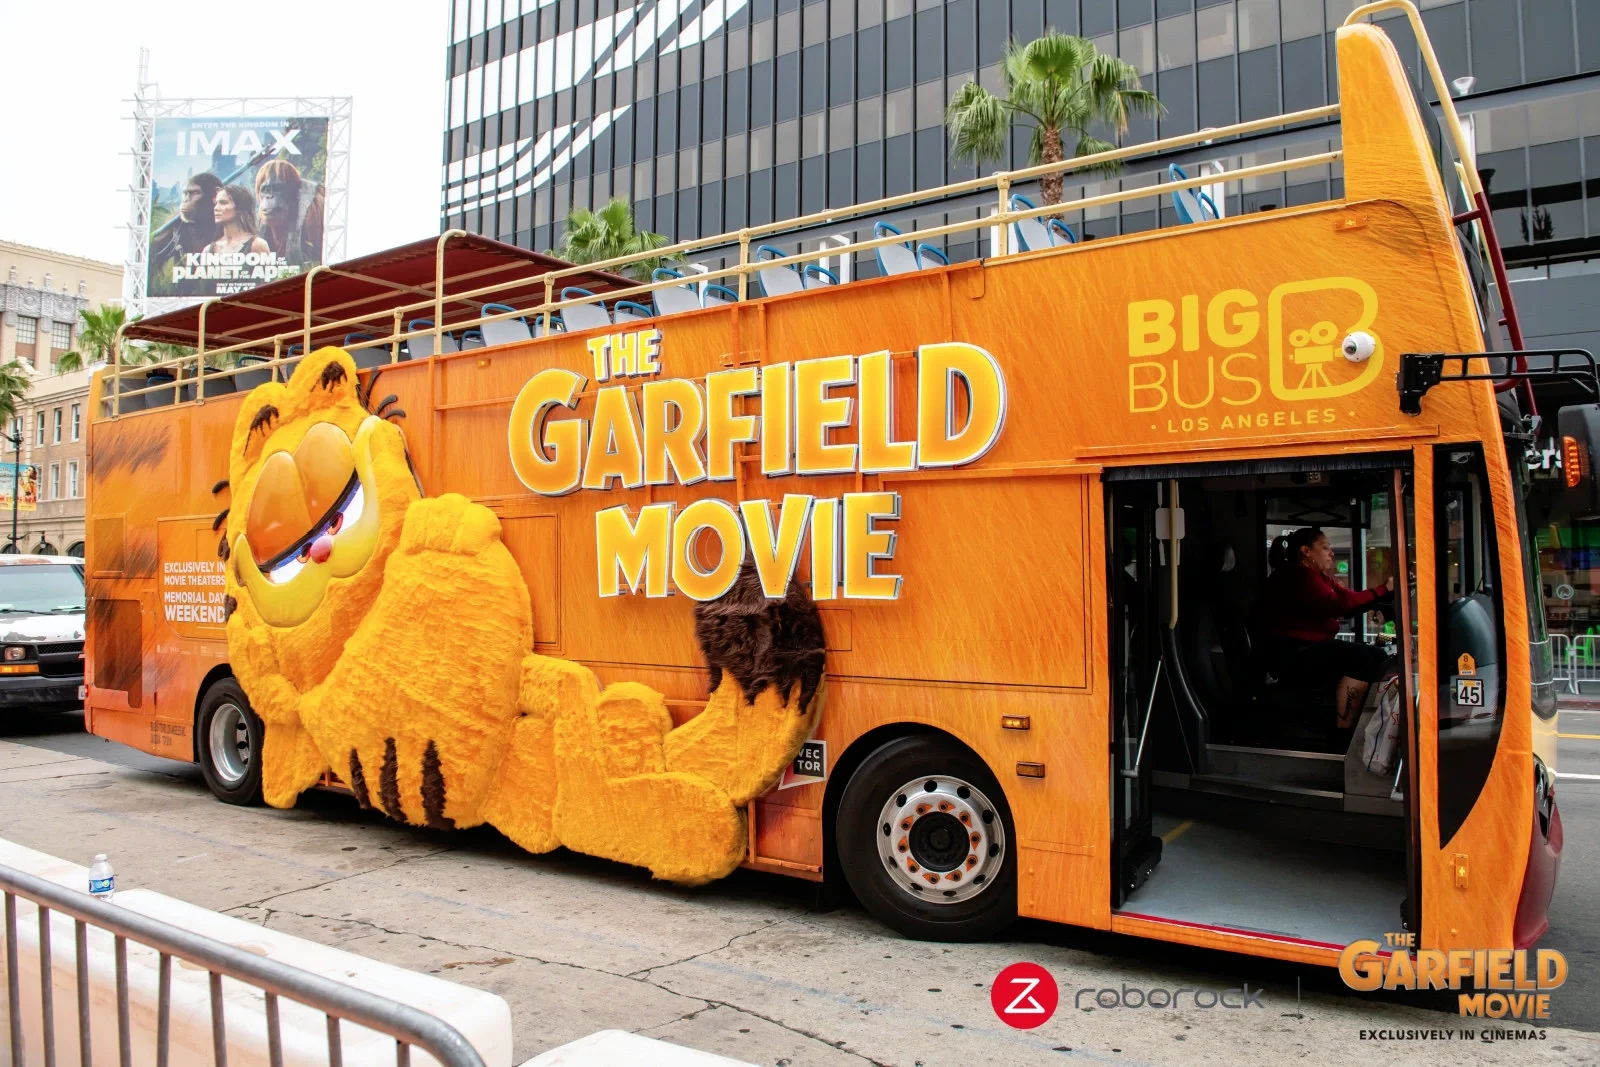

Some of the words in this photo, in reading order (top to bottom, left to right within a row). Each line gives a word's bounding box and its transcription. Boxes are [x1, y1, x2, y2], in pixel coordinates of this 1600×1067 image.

[176, 129, 302, 156] IMAX
[186, 252, 276, 266] KINGDOM
[172, 266, 242, 284] PLANET
[216, 286, 241, 294] MAY
[1127, 288, 1261, 357] BIG
[586, 328, 662, 382] THE
[1128, 352, 1262, 413] BUS
[507, 341, 1008, 497] GARFIELD
[1167, 417, 1209, 433] LOS
[1220, 408, 1336, 430] ANGELES
[595, 491, 903, 602] MOVIE
[164, 561, 215, 573] EXCLUSIVELY
[217, 562, 226, 572] IN
[164, 575, 186, 586] MOVIE
[188, 575, 226, 586] THEATERS
[164, 592, 207, 604] MEMORIAL
[208, 592, 225, 604] DAY
[164, 604, 226, 623] WEEKEND
[1459, 686, 1480, 704] 45
[798, 748, 820, 759] VEC
[797, 760, 821, 771] TOR
